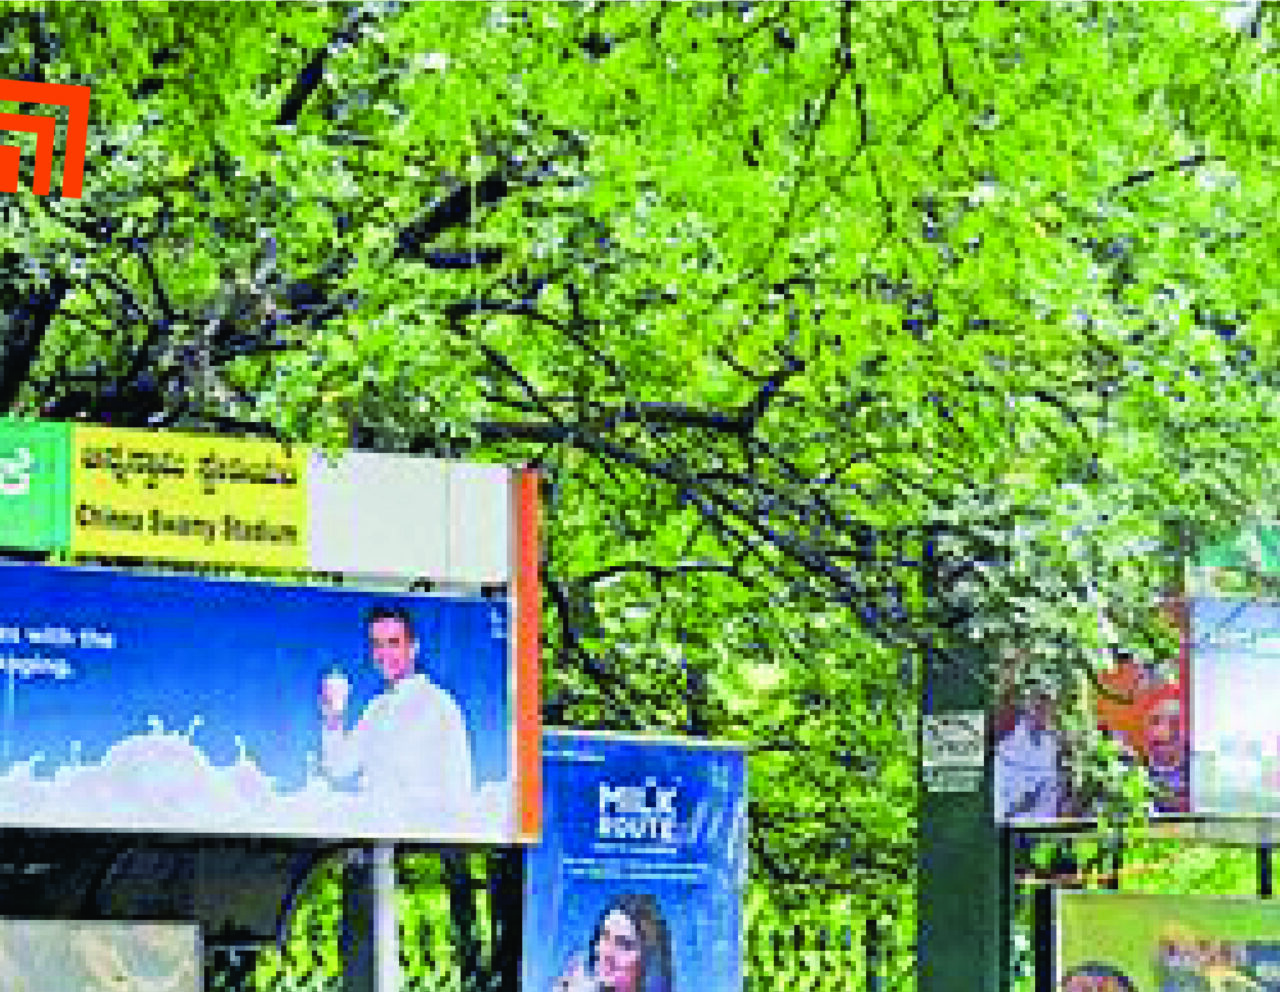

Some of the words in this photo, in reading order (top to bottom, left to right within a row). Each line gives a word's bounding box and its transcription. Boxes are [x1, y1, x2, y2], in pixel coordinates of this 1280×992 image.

[149, 507, 217, 544] Swamy
[221, 514, 298, 543] Stadium
[25, 624, 76, 646] with
[79, 627, 114, 648] the
[598, 782, 677, 817] MILK
